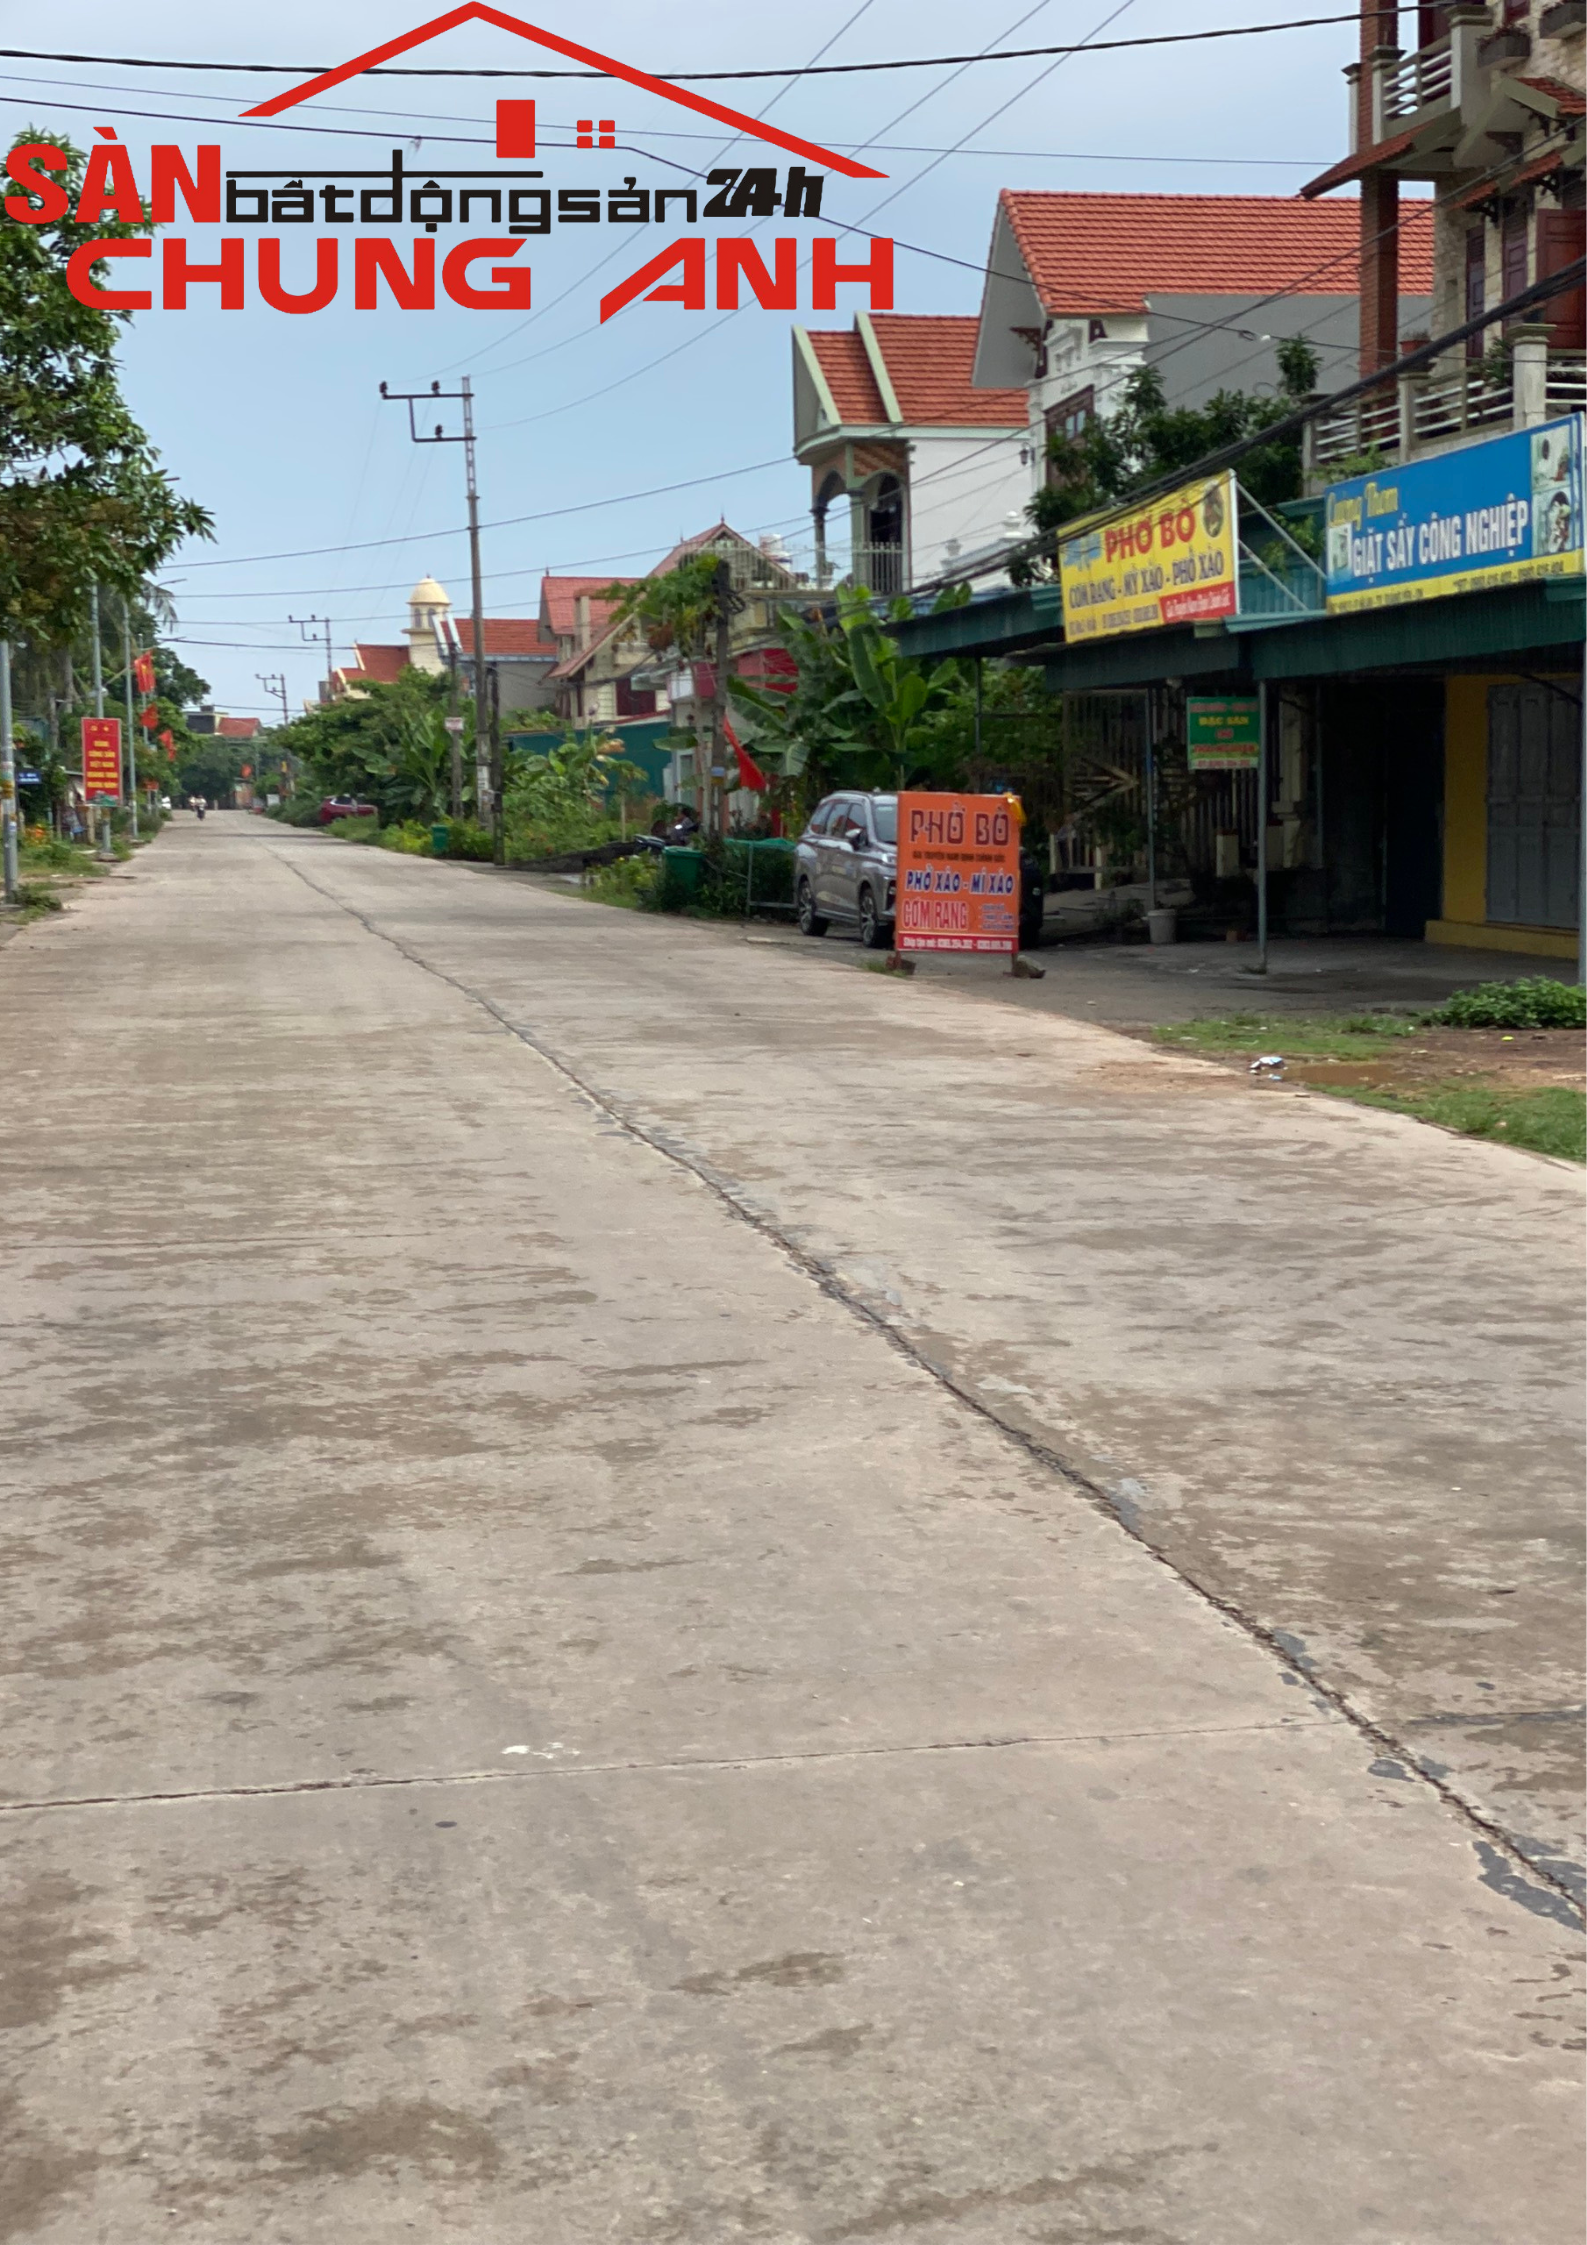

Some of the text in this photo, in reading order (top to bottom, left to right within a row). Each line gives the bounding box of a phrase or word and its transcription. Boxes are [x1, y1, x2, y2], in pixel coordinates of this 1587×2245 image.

[1353, 493, 1529, 583] GIẶT SẤY CÔNG NGHIỆP
[911, 801, 966, 844] PHỞ
[934, 900, 968, 930] RANG
